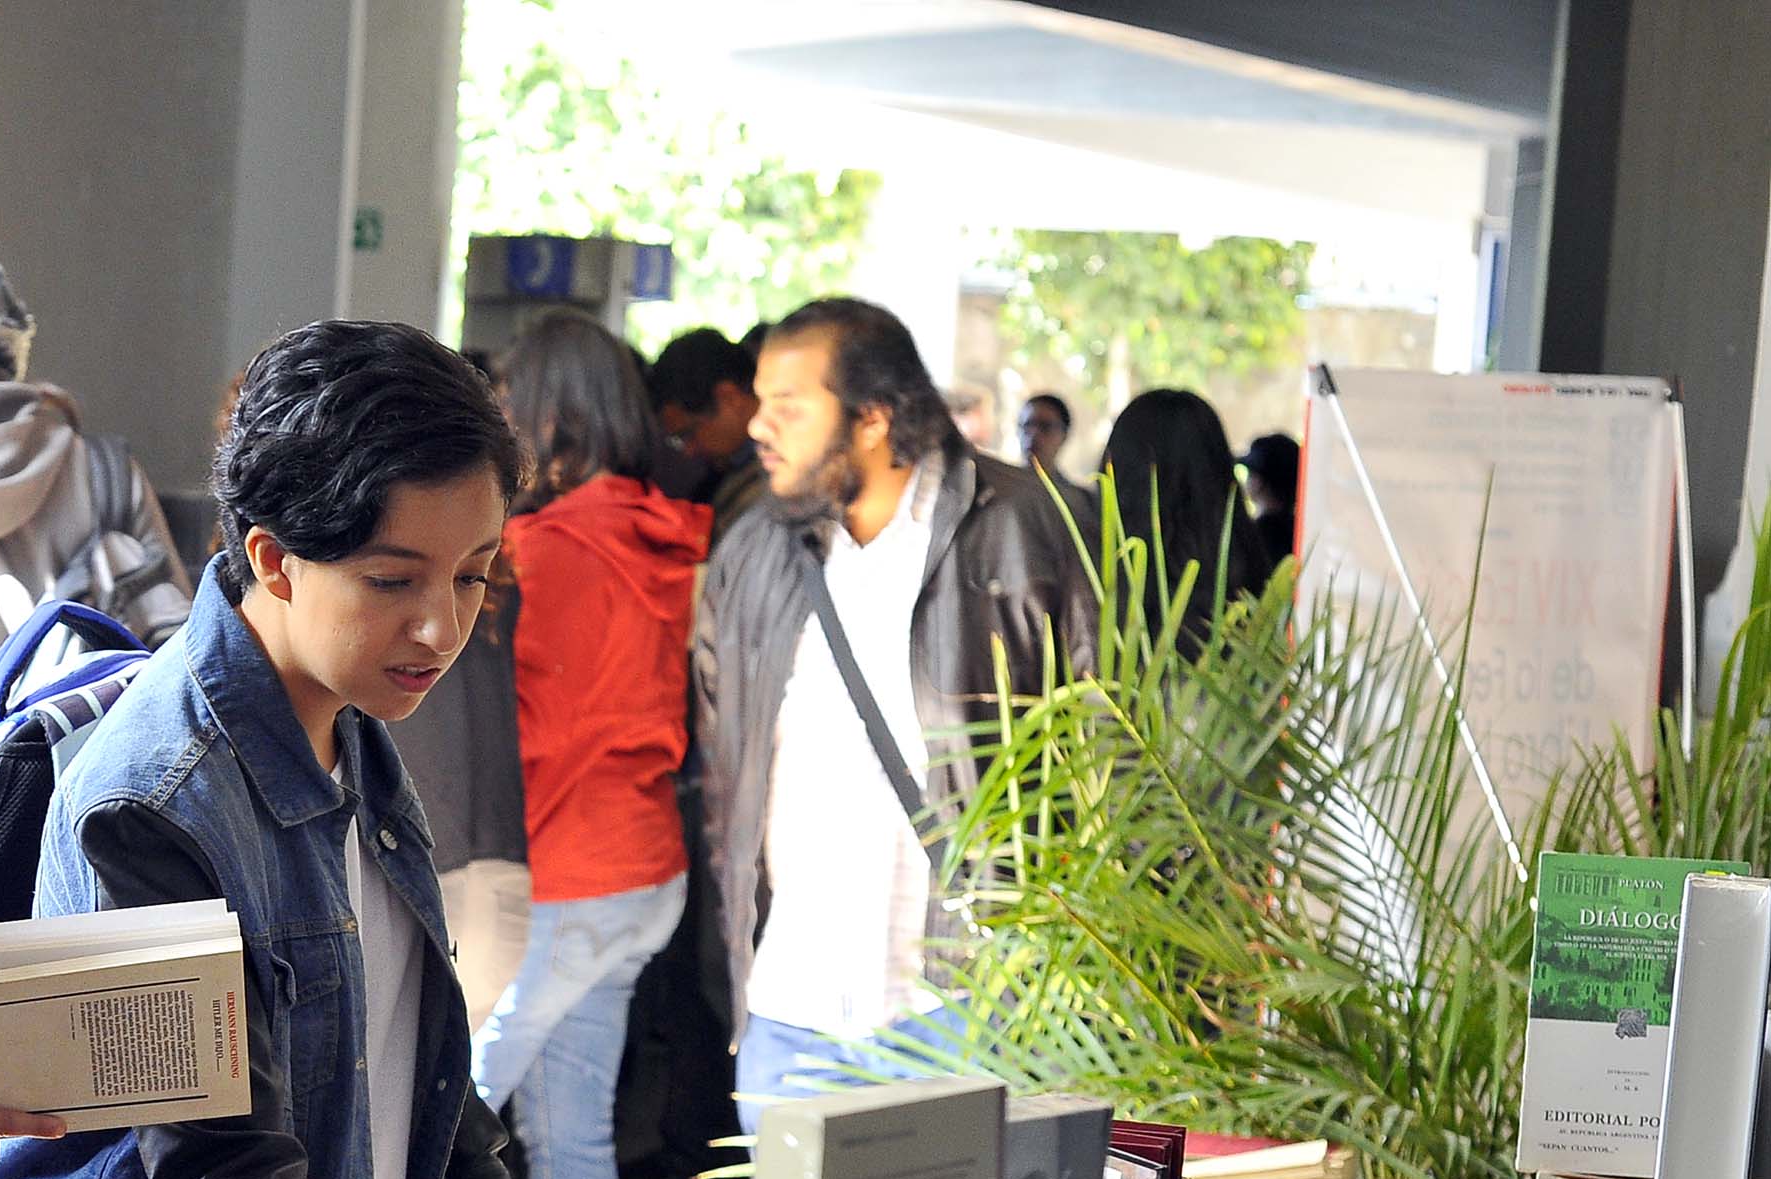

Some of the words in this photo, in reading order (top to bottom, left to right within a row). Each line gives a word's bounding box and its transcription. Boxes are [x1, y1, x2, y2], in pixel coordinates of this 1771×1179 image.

[1580, 906, 1681, 929] DIÁLOGO
[1545, 1110, 1633, 1126] EDITORIAL
[1640, 1116, 1660, 1128] PO
